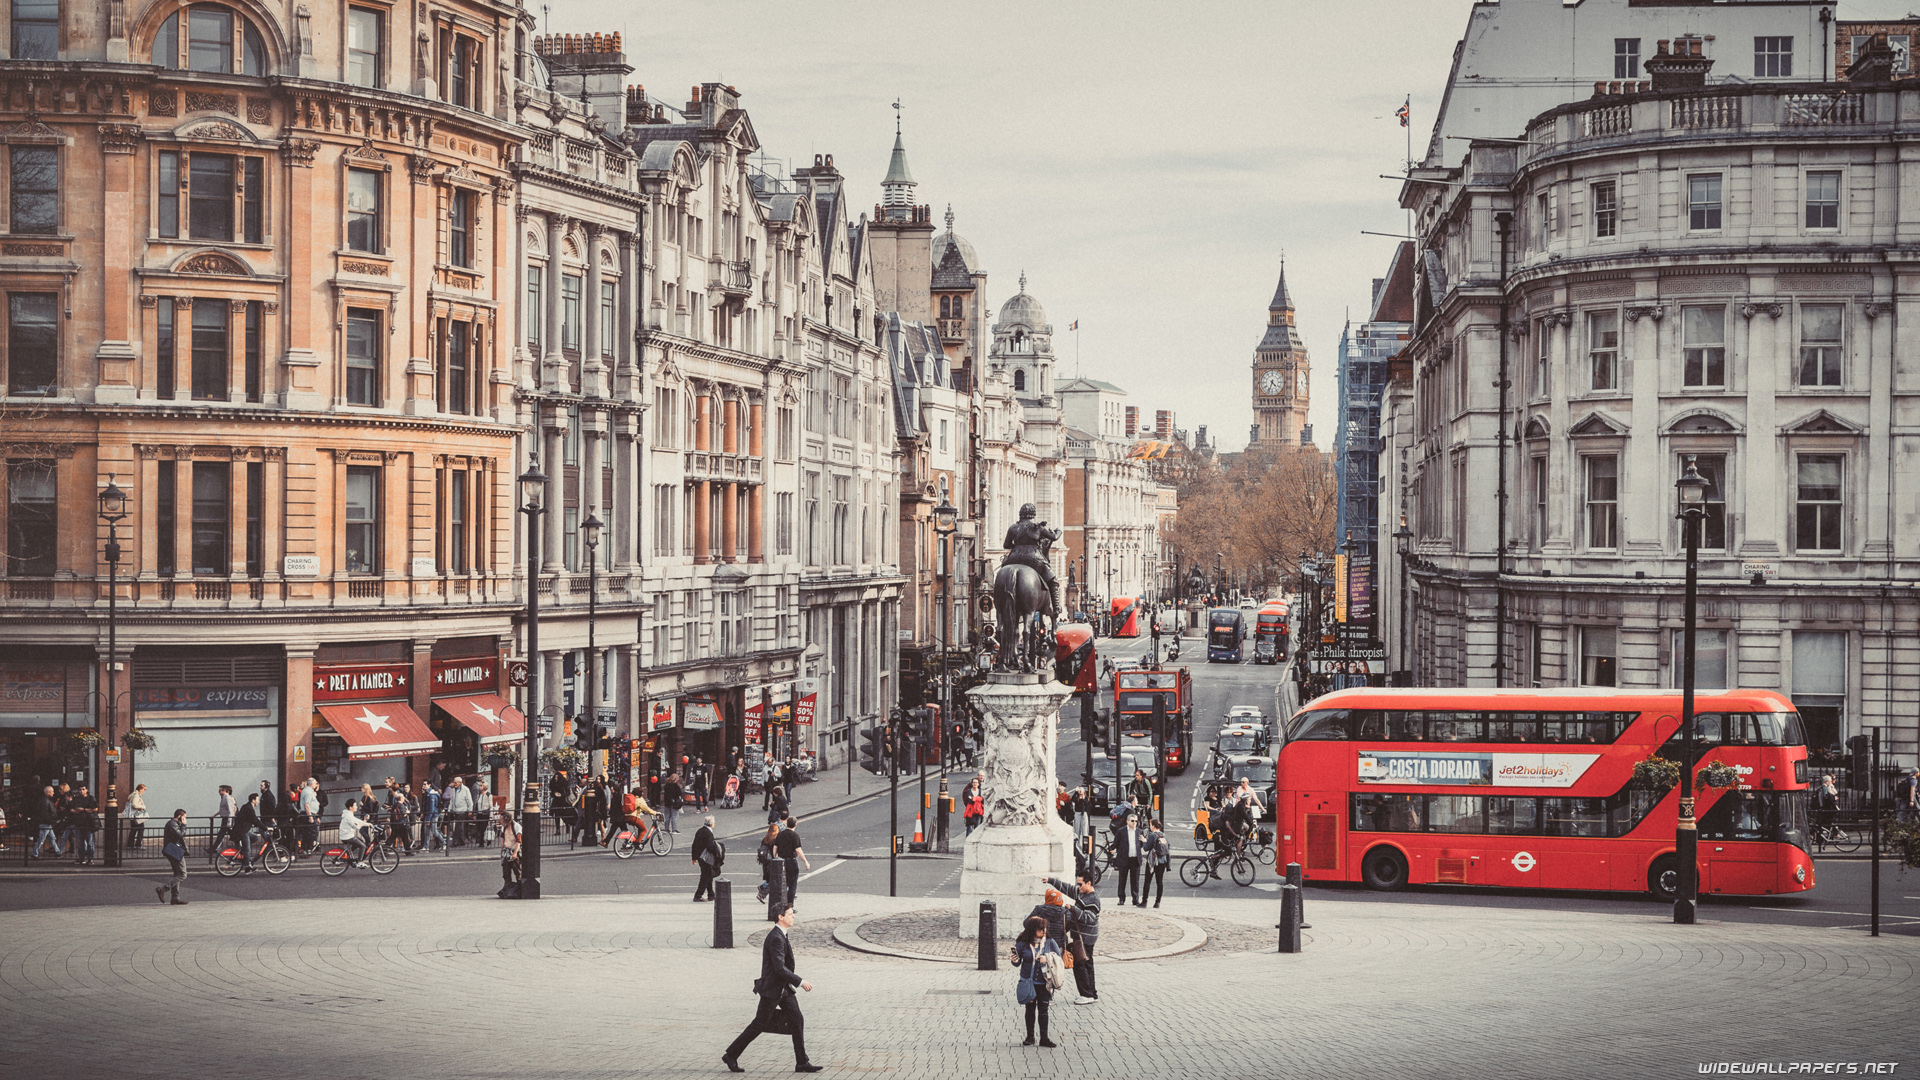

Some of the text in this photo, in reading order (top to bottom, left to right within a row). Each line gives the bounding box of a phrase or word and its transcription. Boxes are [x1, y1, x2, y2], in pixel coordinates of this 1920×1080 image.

[1324, 645, 1384, 660] Philathropist
[444, 668, 457, 684] PRET
[463, 666, 483, 682] MANGER
[329, 672, 393, 691] PRET A MANGER
[6, 688, 59, 702] express
[137, 688, 267, 704] TESCO express
[798, 700, 814, 708] SALE
[745, 711, 761, 719] SALE
[796, 707, 813, 716] 50%
[745, 719, 761, 728] 50%
[797, 715, 810, 723] OFF
[745, 728, 758, 736] OFF
[1388, 759, 1481, 780] COSTA DORADA
